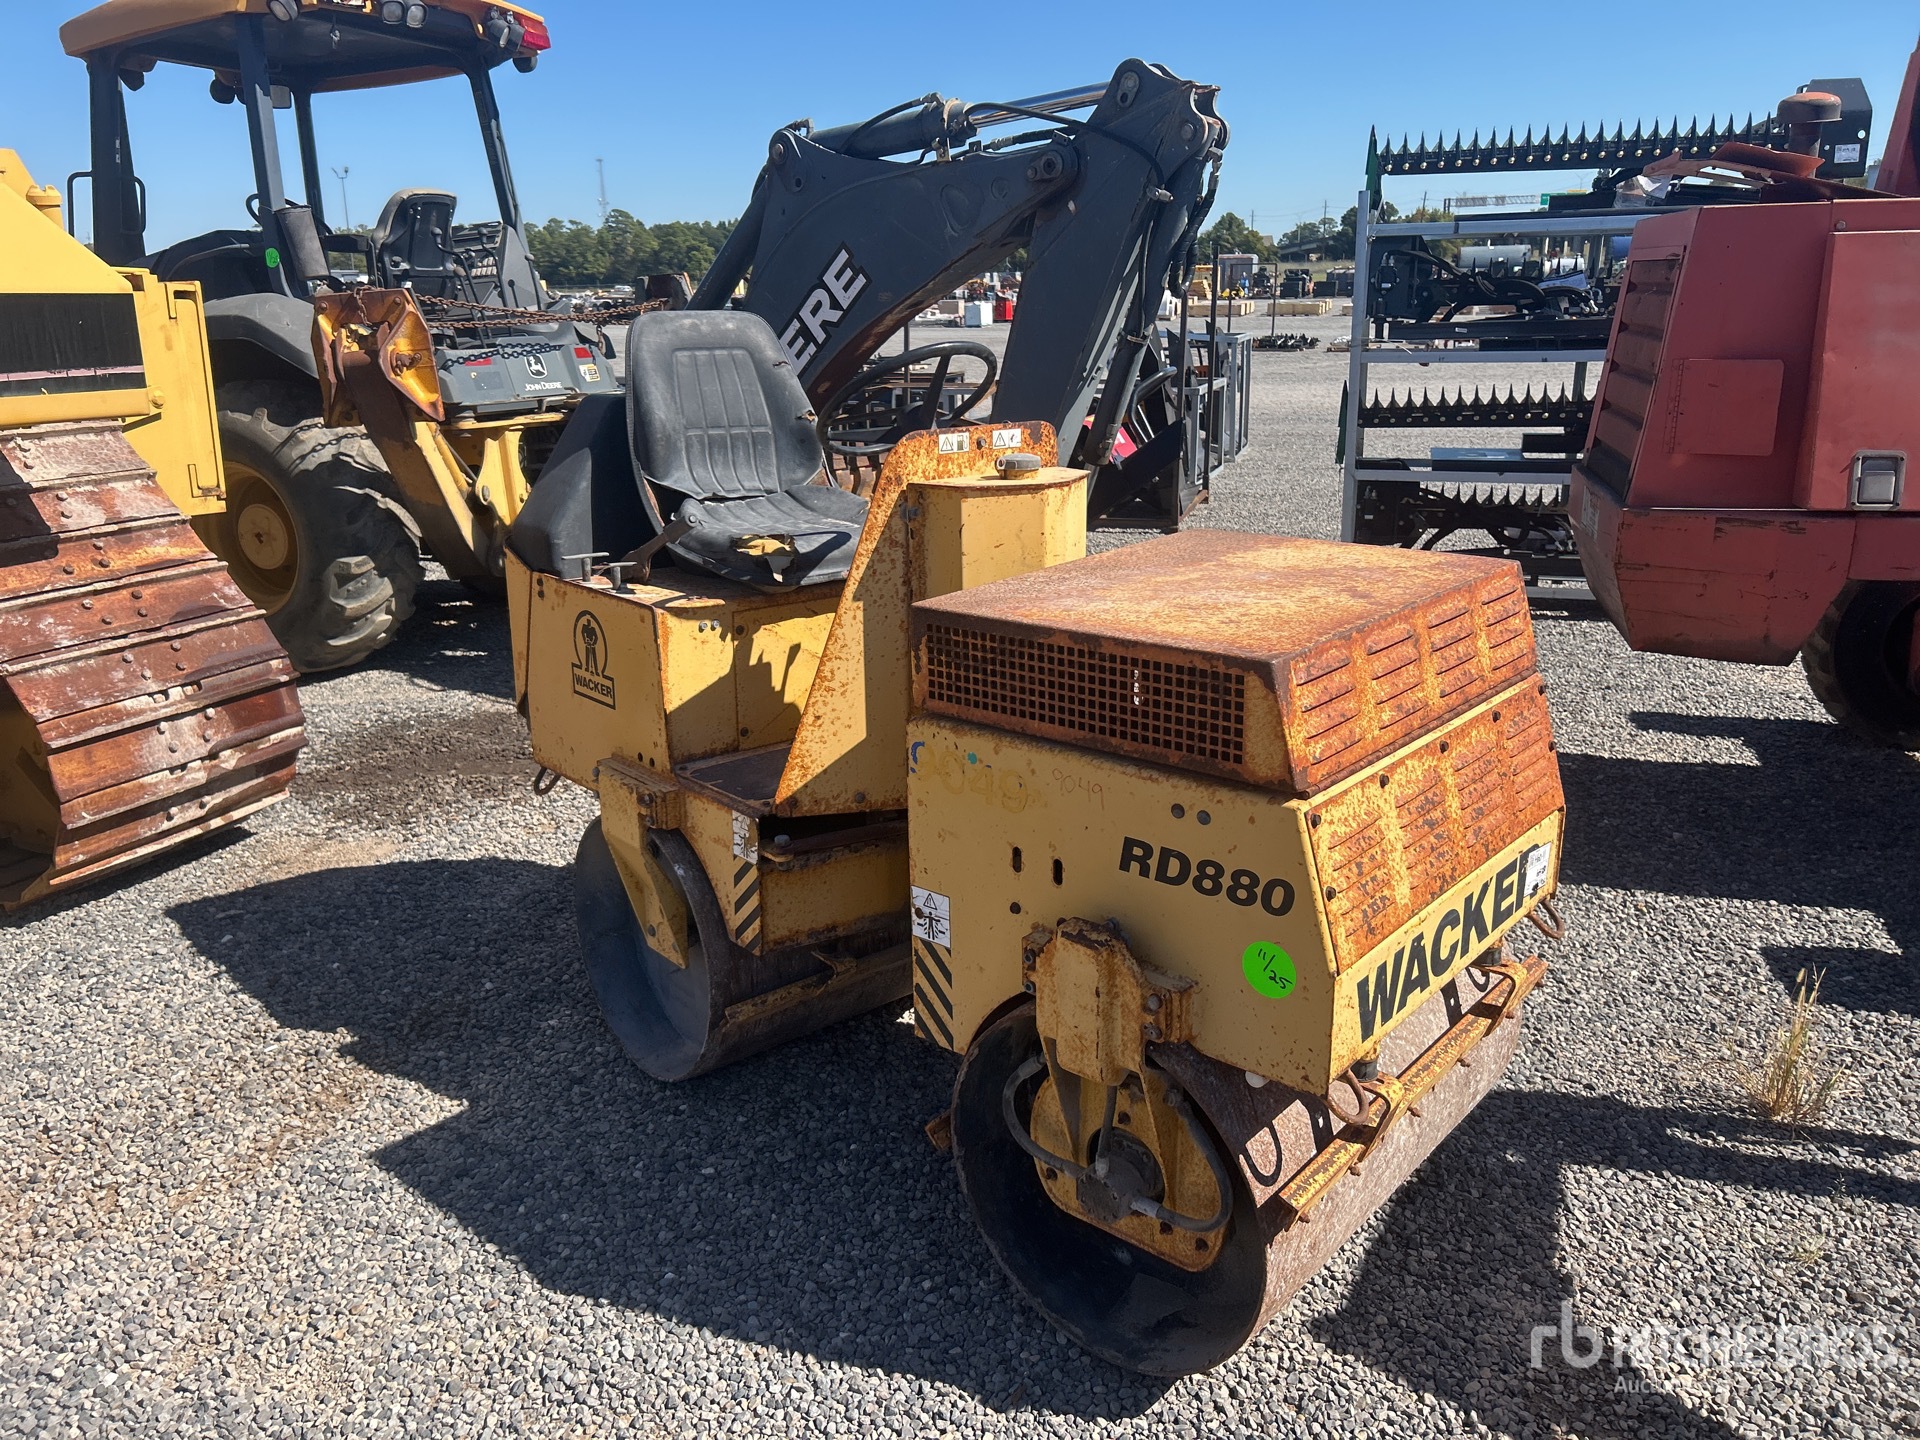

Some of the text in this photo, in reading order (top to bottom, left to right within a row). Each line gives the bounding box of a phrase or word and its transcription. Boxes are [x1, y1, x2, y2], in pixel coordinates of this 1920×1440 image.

[525, 381, 562, 391] JOHN DEERE
[574, 673, 613, 699] WACKER
[1052, 768, 1105, 811] 9049
[1119, 836, 1296, 917] RD880
[1257, 948, 1293, 990] 11/25
